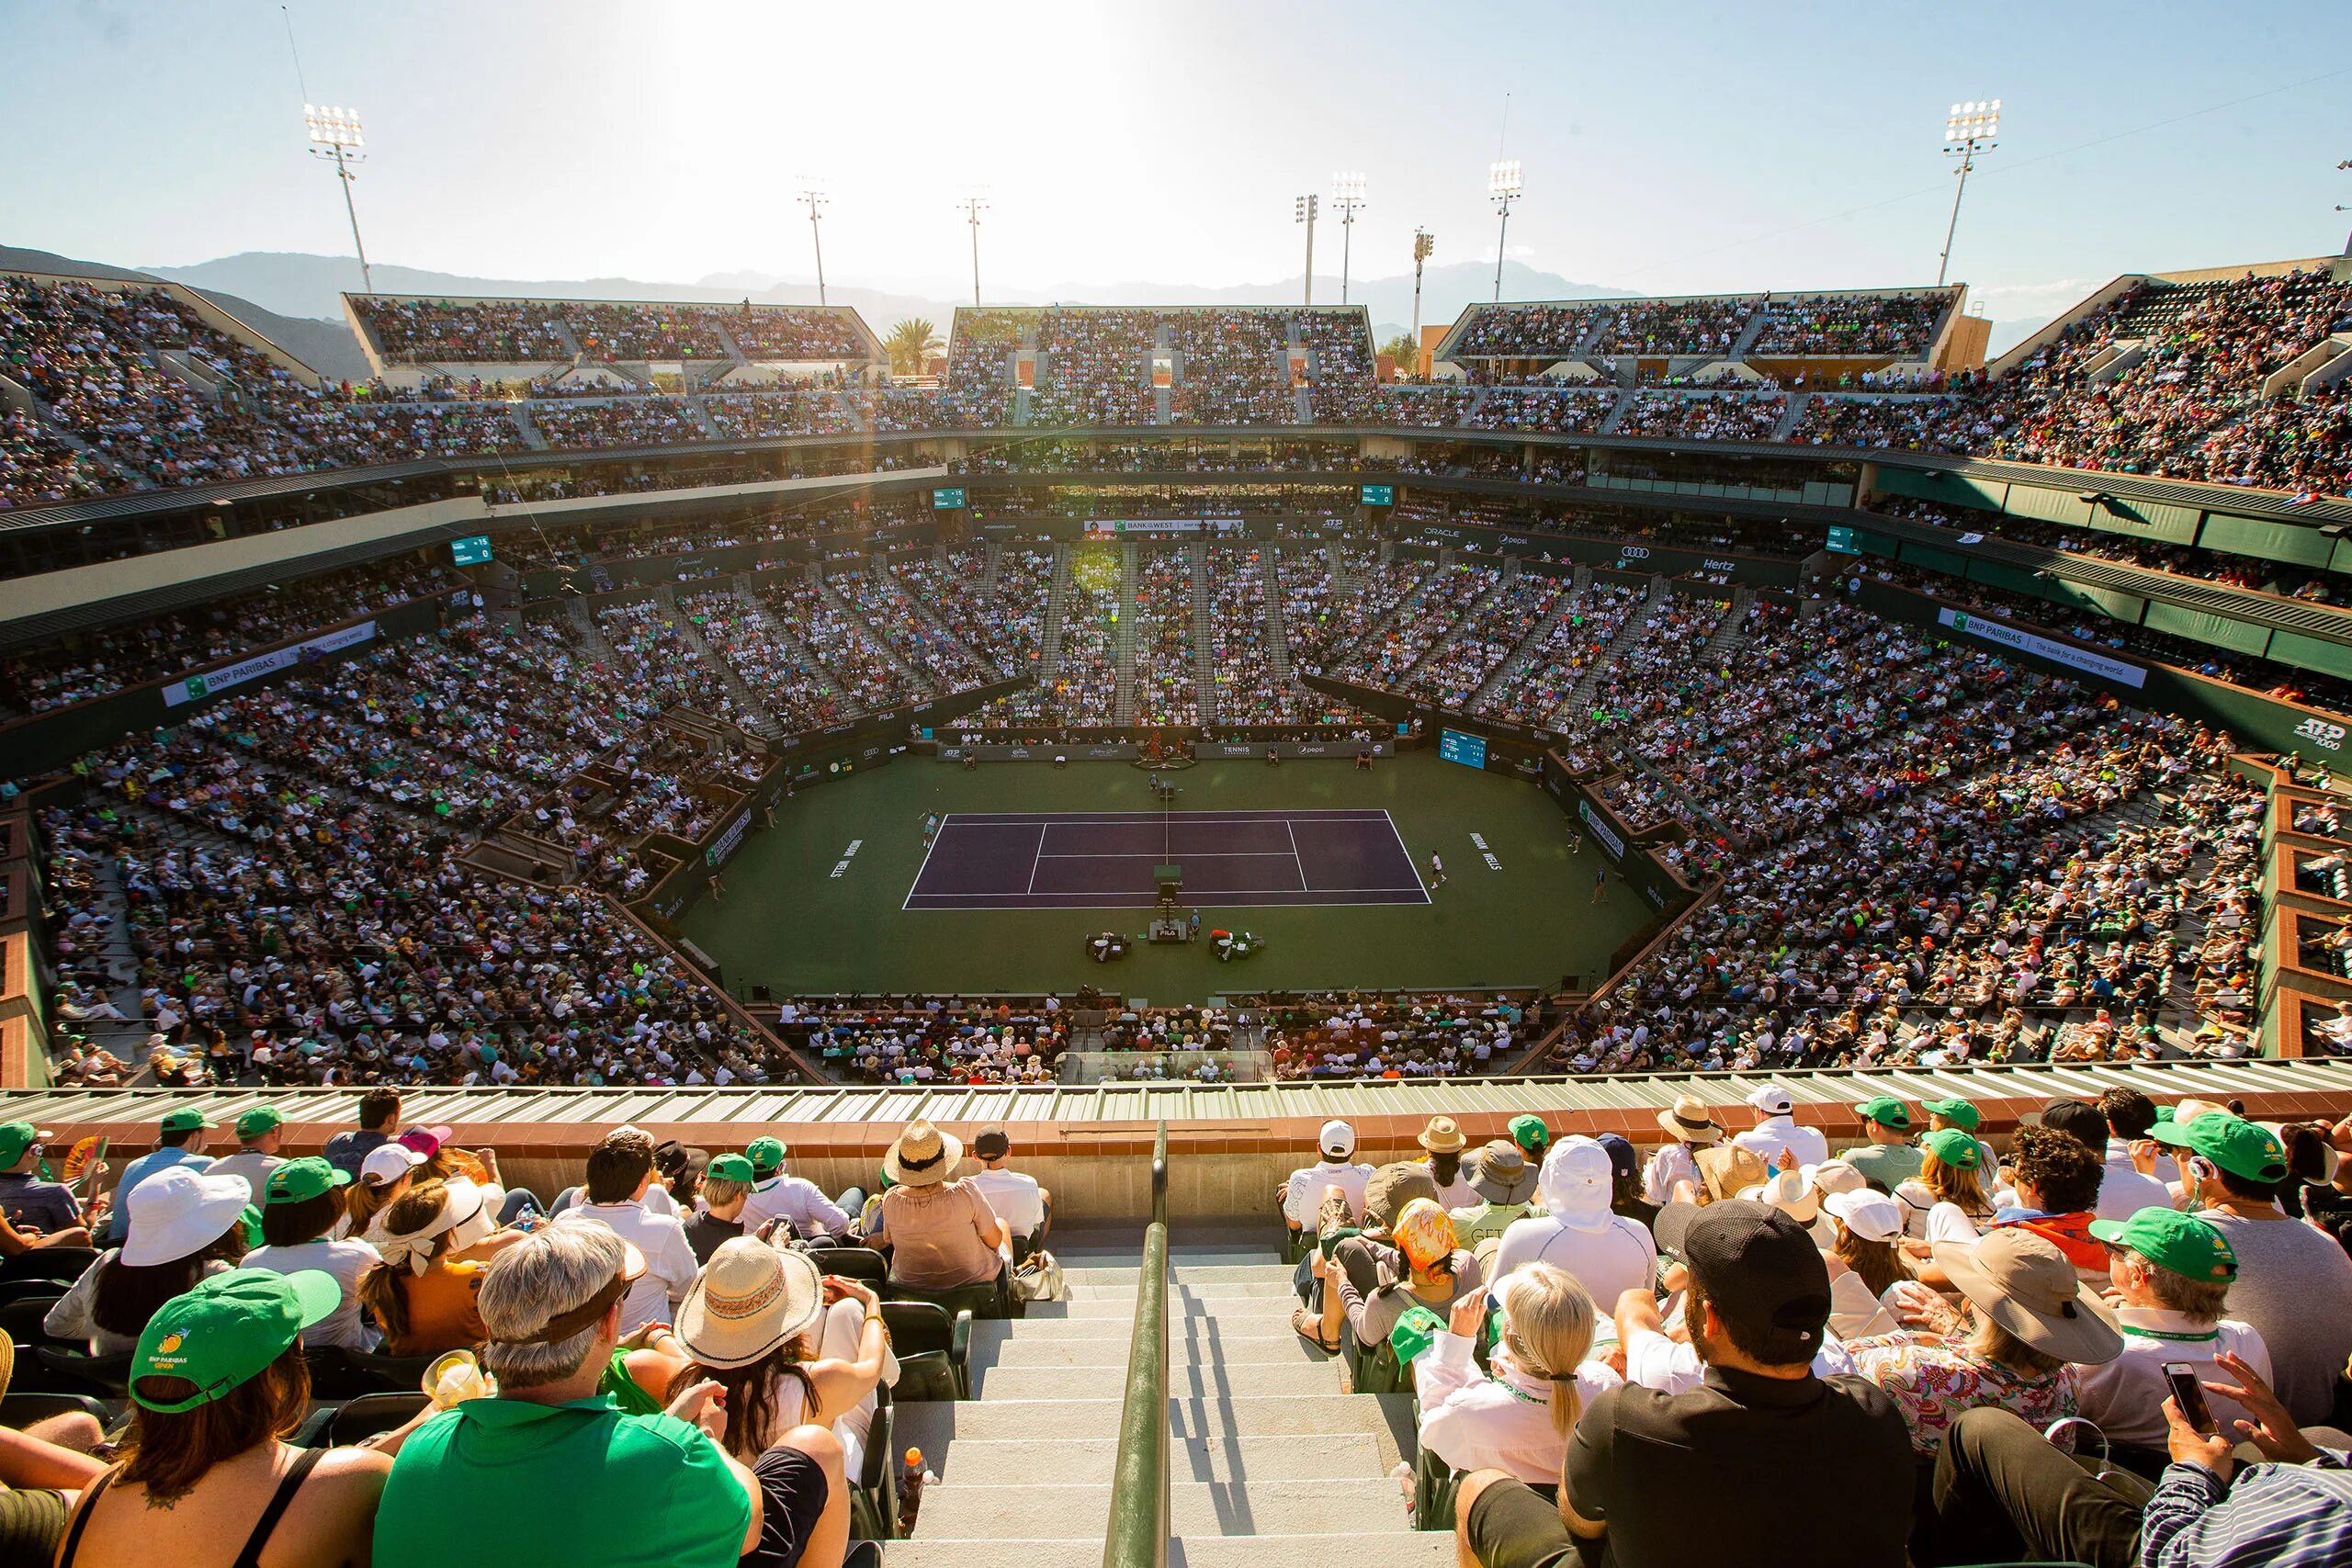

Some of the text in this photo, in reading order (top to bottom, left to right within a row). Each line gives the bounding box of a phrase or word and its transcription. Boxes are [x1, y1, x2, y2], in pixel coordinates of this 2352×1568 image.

[1424, 527, 1461, 537] ORACLE
[1508, 536, 1528, 545] pepsi
[482, 549, 489, 558] 0
[1703, 558, 1736, 571] Hertz
[1968, 620, 1985, 632] BNP
[1985, 626, 2023, 645] PARIBAS
[2036, 641, 2045, 651] The
[2047, 645, 2061, 655] bank
[2061, 649, 2072, 660] for
[2076, 655, 2104, 671] changing
[208, 672, 231, 688] BNP
[233, 657, 278, 681] PARIBAS
[878, 712, 895, 721] FILA
[823, 722, 854, 735] ORACLE
[1492, 720, 1521, 730] CHANDON
[2294, 718, 2346, 739] ATP
[2315, 738, 2341, 750] 1000
[715, 836, 730, 856] BANK
[735, 810, 750, 833] WEST
[1589, 811, 1600, 828] BNP
[1600, 823, 1622, 854] PARIBAS
[1470, 833, 1503, 871] INDIAN WELLS
[830, 861, 851, 878] WELLS
